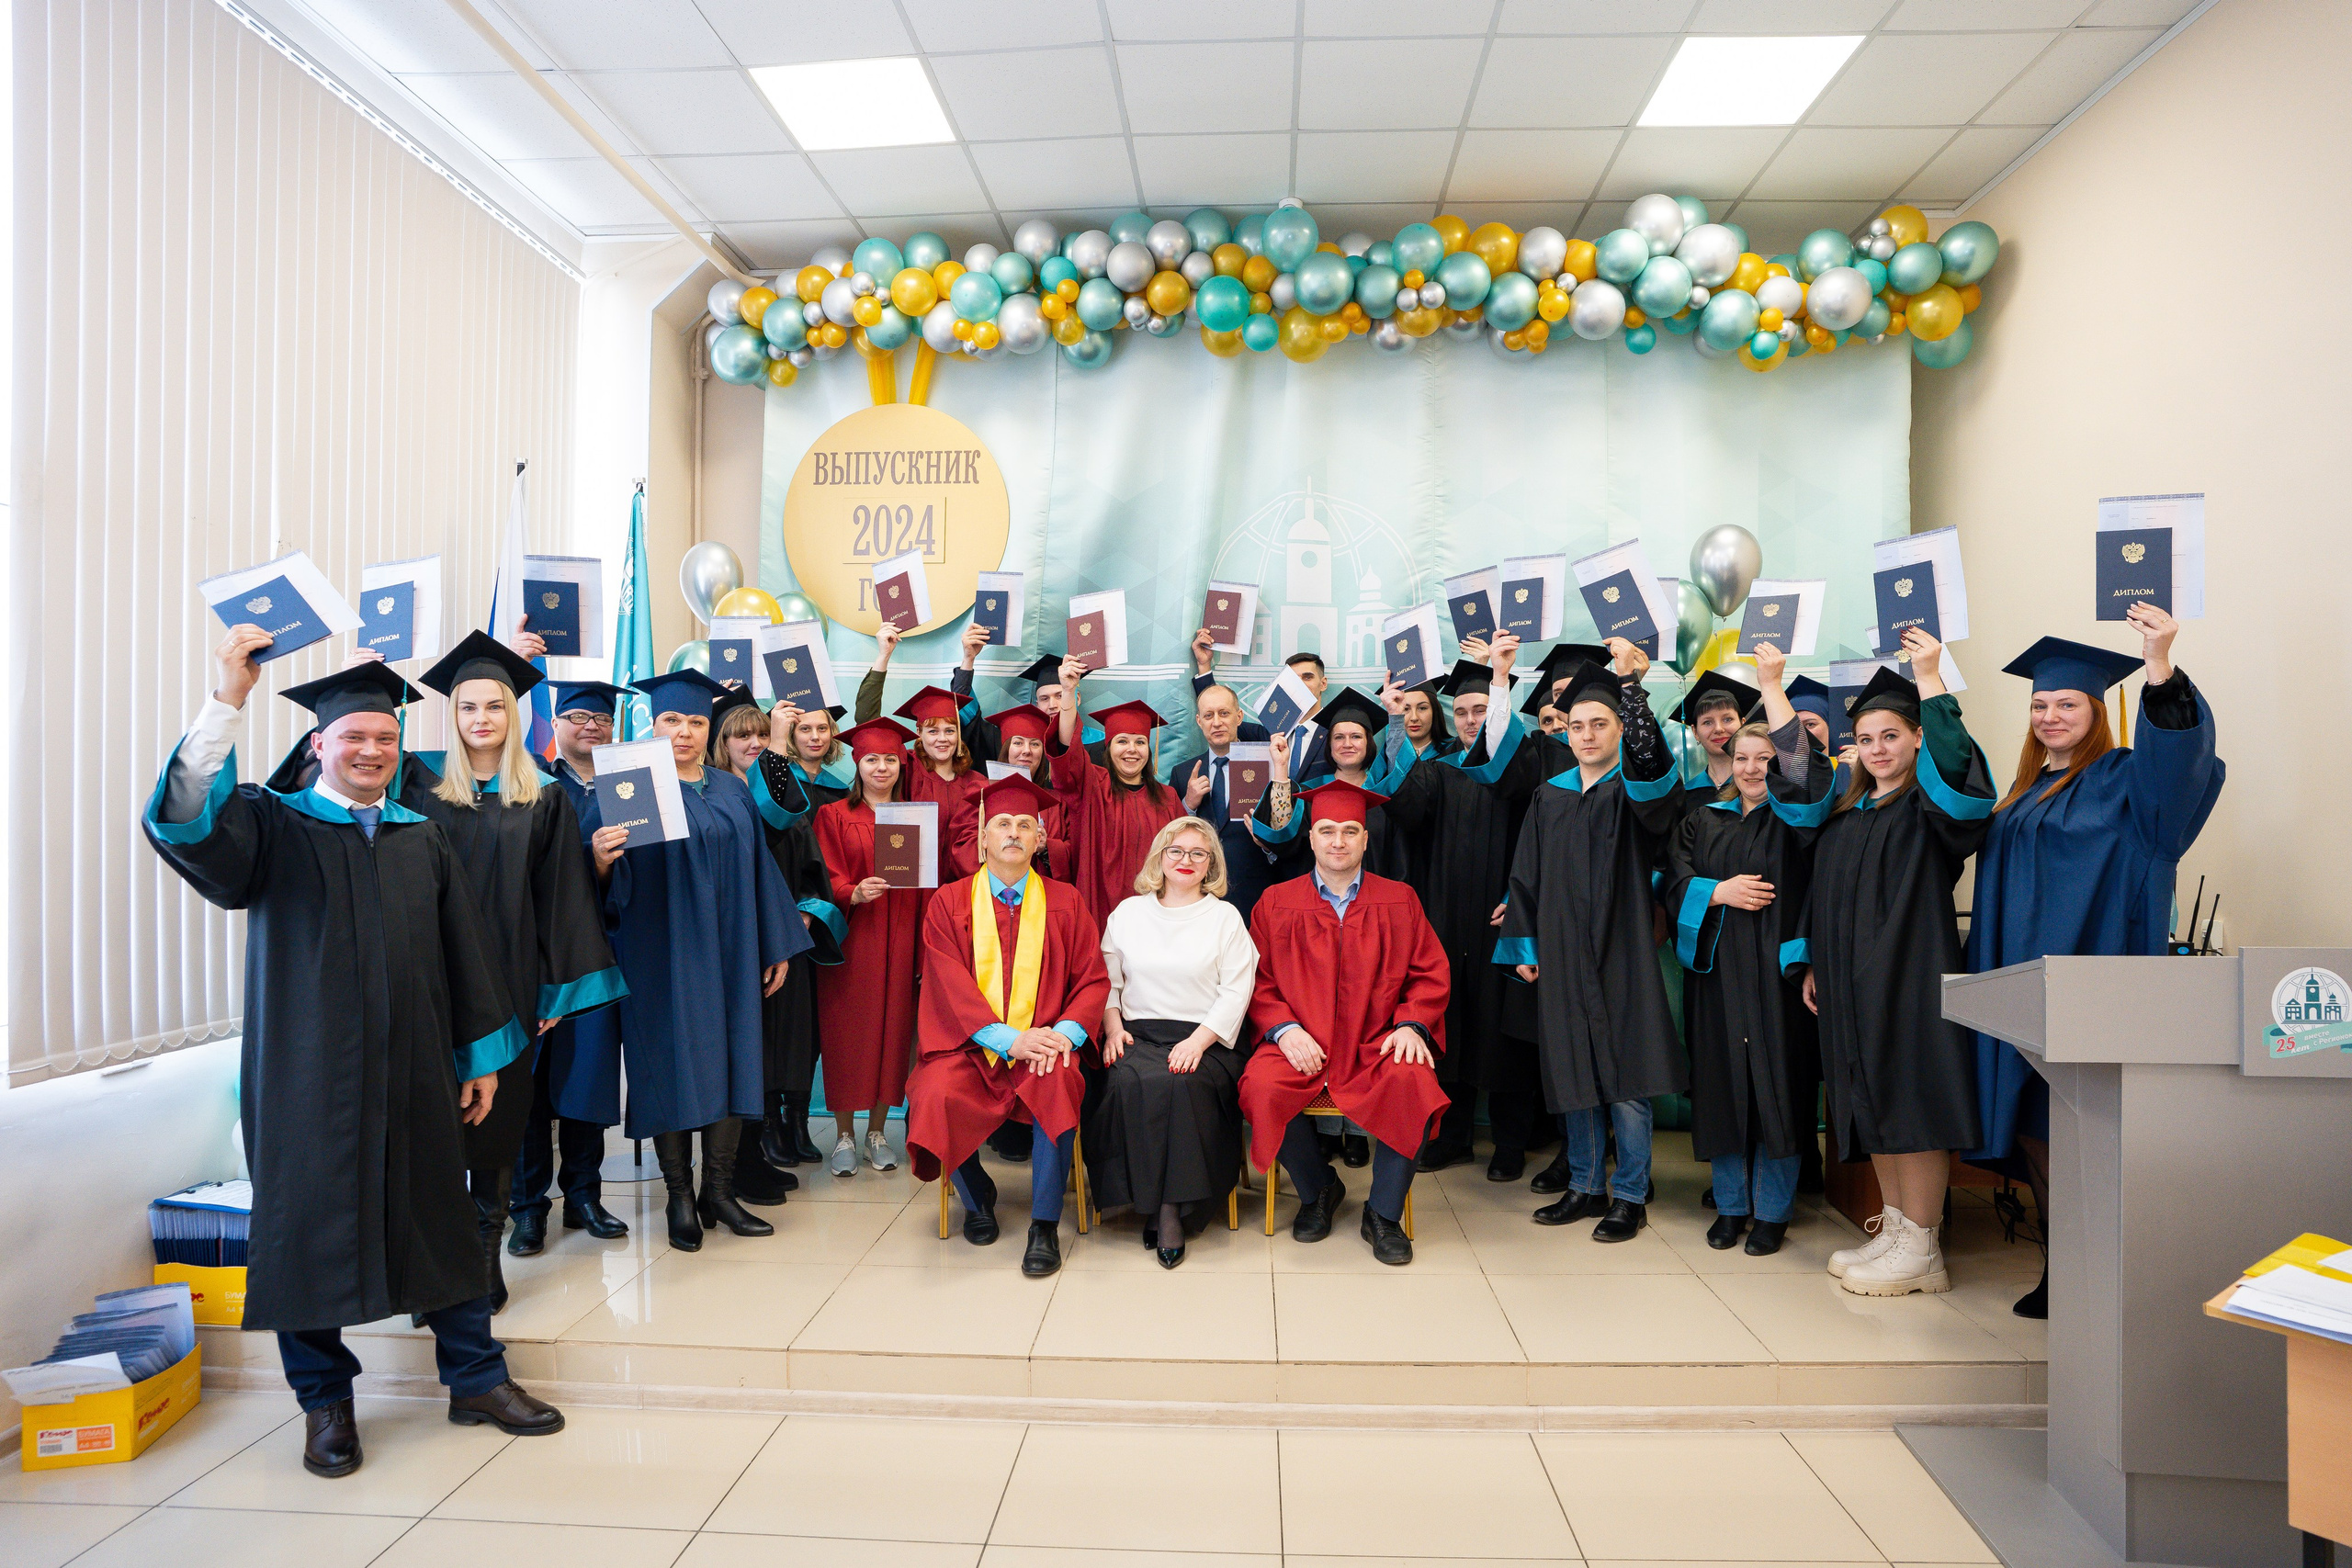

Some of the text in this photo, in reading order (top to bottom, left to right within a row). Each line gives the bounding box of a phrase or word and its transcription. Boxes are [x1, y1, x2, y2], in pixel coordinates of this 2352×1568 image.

[813, 449, 981, 486] ВЫПУСКНИК
[853, 503, 936, 557] 2024
[2112, 588, 2154, 597] ДИПЛОМ
[1508, 619, 1532, 627] ДИПЛОМ
[1611, 615, 1639, 631] ДИПЛОМ
[1891, 617, 1925, 630] ДИПЛОМ
[368, 633, 400, 646] ДИПЛОМ
[786, 689, 811, 699] ДИПЛОМ
[2304, 1031, 2330, 1041] вместе
[2276, 1036, 2296, 1053] 25
